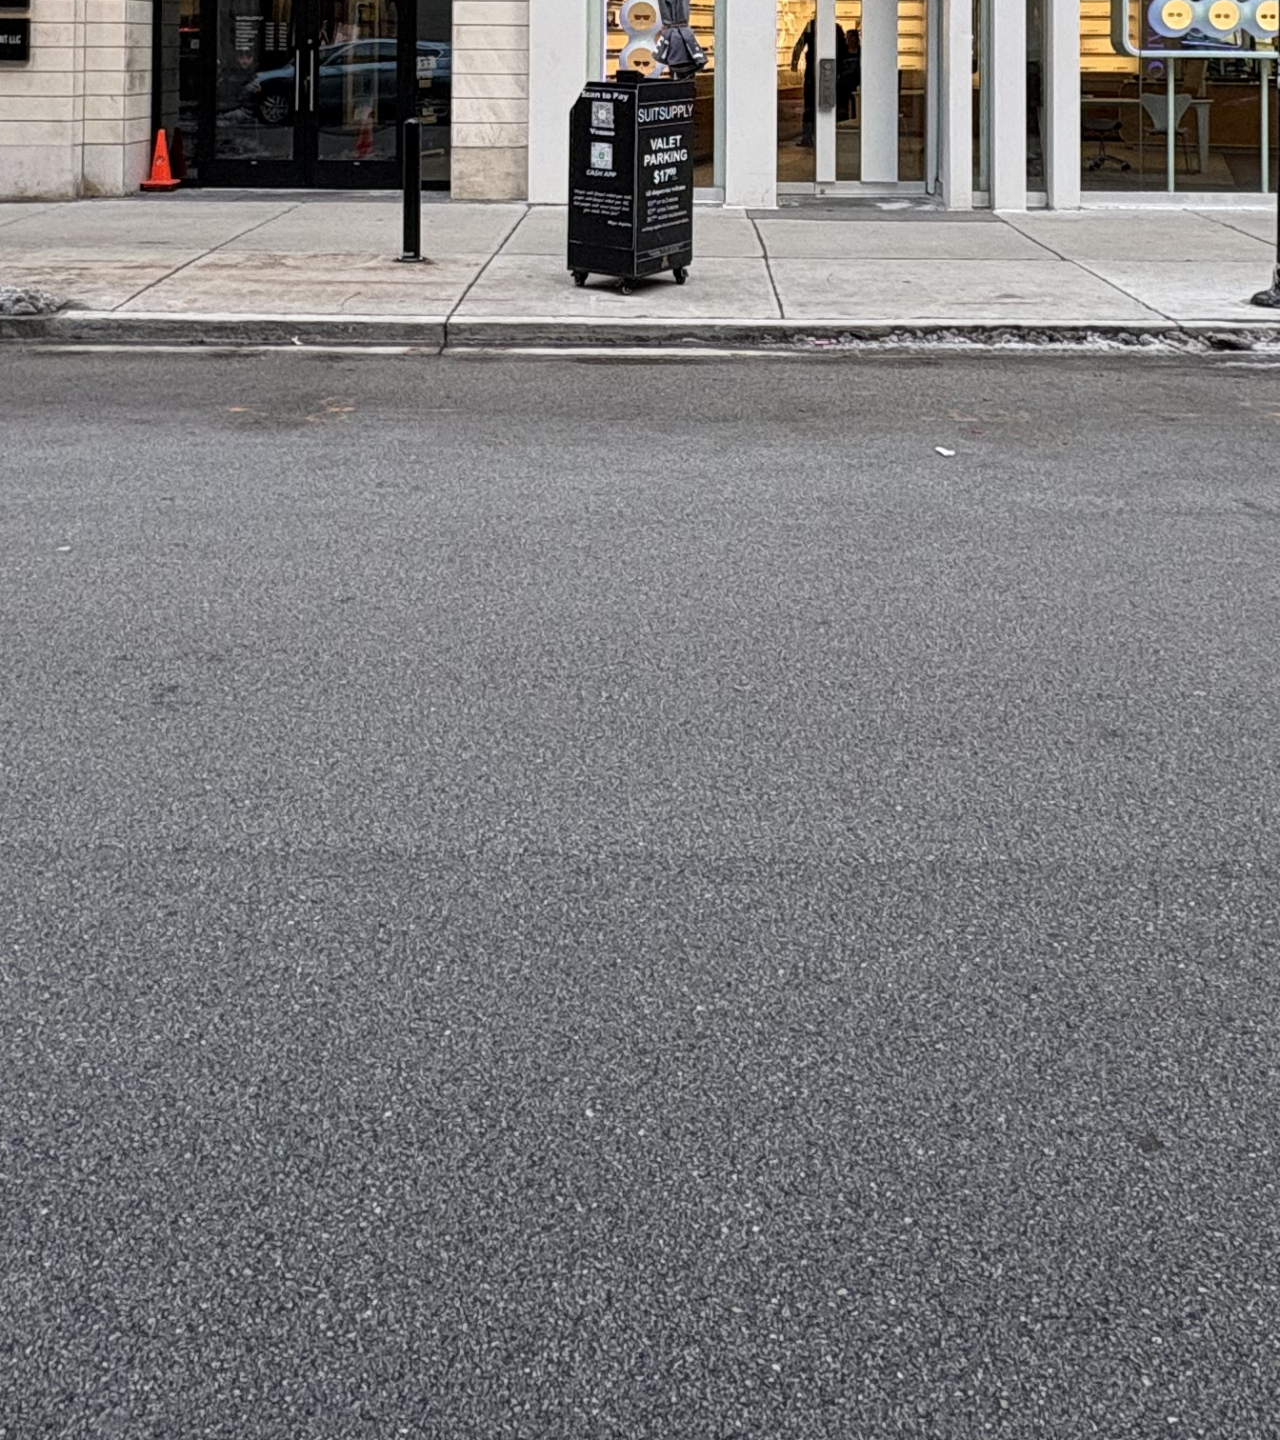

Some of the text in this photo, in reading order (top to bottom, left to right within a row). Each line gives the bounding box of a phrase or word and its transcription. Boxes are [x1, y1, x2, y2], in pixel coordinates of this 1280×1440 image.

[581, 90, 629, 103] Scan to Pay
[637, 104, 694, 123] SUITSUPPLY
[650, 135, 682, 151] VALET
[643, 148, 688, 167] PARKING
[586, 169, 617, 178] CASH APP
